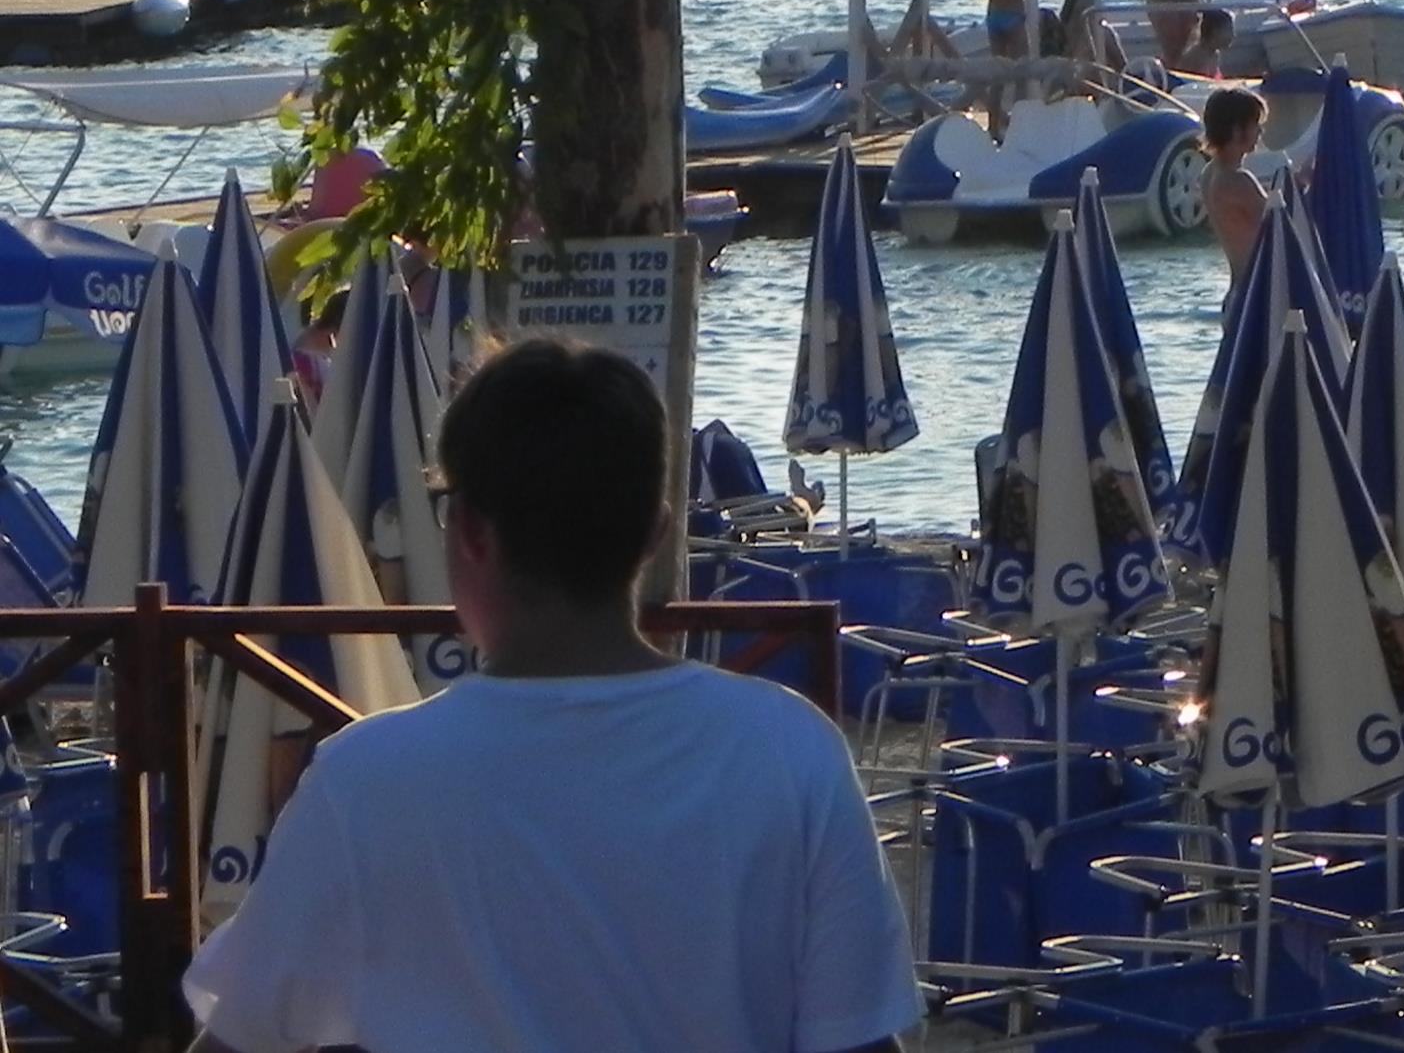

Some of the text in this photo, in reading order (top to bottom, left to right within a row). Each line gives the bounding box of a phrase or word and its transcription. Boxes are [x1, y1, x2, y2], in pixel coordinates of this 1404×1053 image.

[521, 250, 669, 274] POICIA 129
[84, 270, 145, 308] Golf
[627, 277, 667, 298] 128
[627, 303, 666, 325] 127
